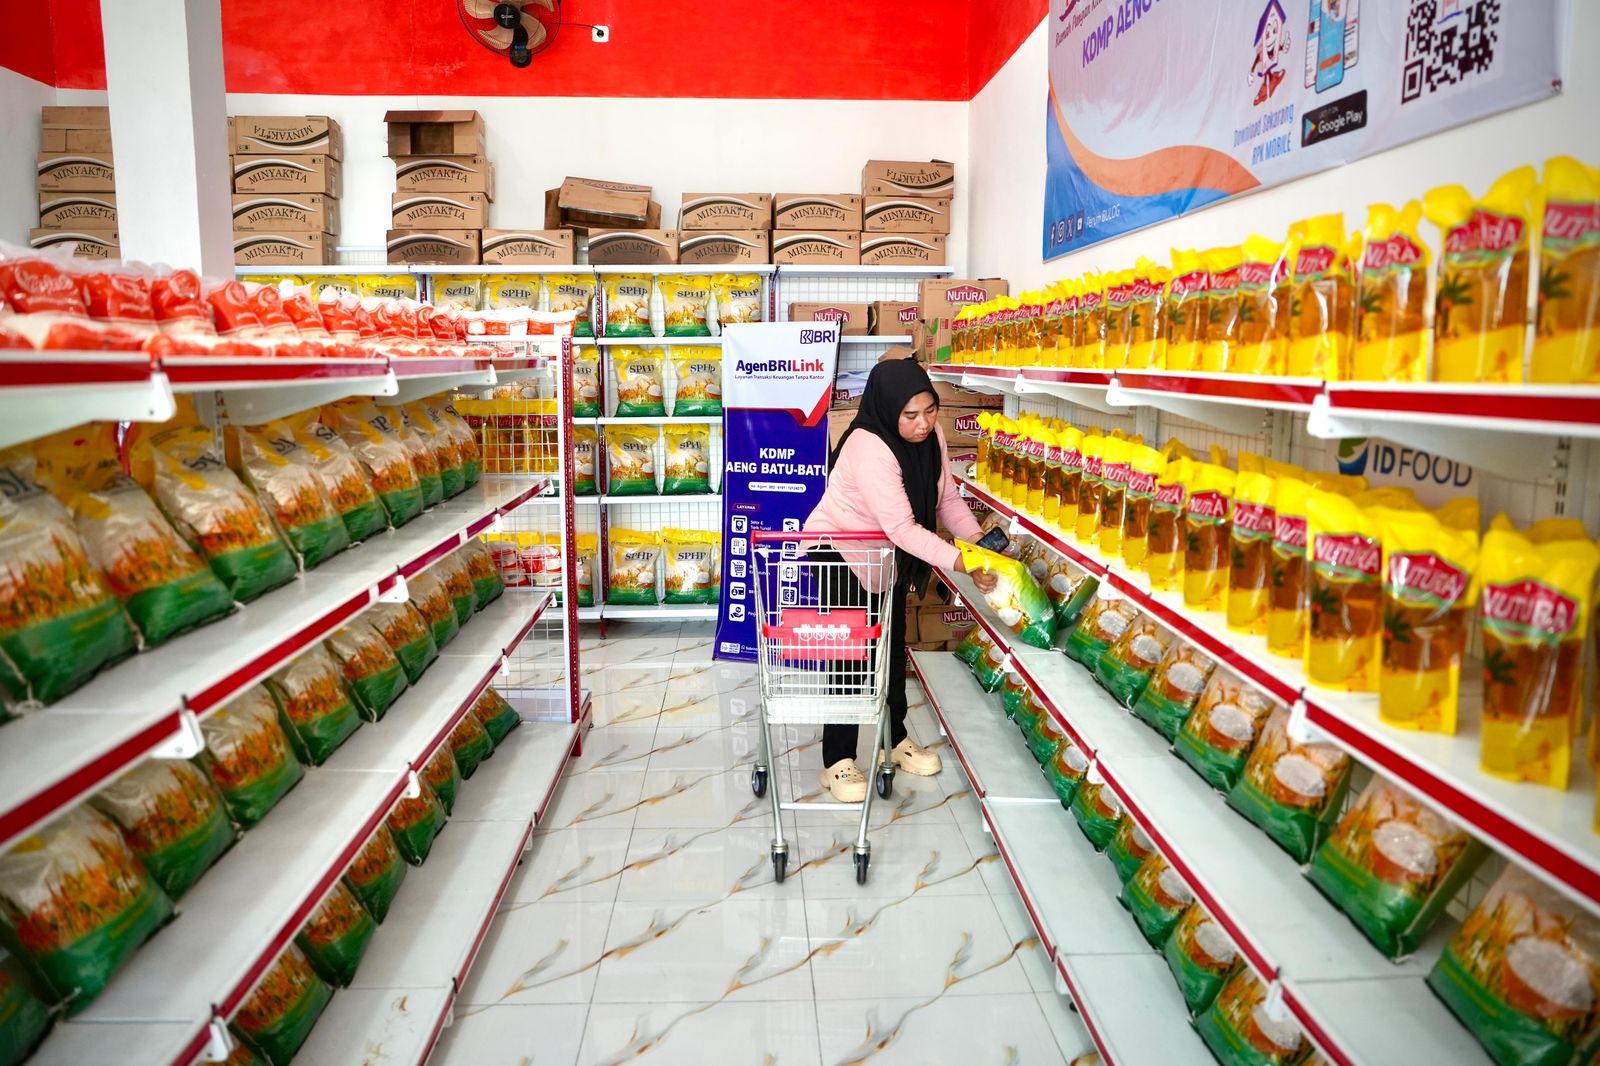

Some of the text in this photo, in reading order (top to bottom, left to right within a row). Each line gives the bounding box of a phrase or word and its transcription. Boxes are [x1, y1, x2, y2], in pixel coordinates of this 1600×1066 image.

[1082, 15, 1114, 68] KDMP
[1318, 110, 1363, 133] Google Play
[253, 124, 314, 141] MINYAKITA
[52, 167, 113, 182] MINYAKITA
[248, 169, 308, 184] MINYAKITA
[410, 169, 468, 184] MINYAKITA
[886, 168, 941, 184] MINYAKITA
[55, 207, 116, 223] MINYAKITA
[247, 208, 307, 224] MINYAKITA
[407, 206, 466, 221] MINYAKITA
[696, 206, 754, 221] MINYAKITA
[790, 208, 846, 222] MINYAKITA
[879, 211, 934, 225] MINYAKITA
[75, 243, 109, 258] AKITA
[244, 245, 304, 261] MINYAKITA
[496, 243, 556, 260] MINYAKITA
[602, 241, 660, 257] MINYAKITA
[694, 244, 751, 259] MINYAKITA
[787, 244, 844, 259] MINYAKITA
[874, 247, 930, 261] MINYAKITA
[375, 288, 405, 297] SPHP
[501, 289, 531, 298] SPHP
[558, 285, 588, 297] SPHP
[619, 287, 648, 298] SPHP
[947, 290, 985, 301] NUTURA
[814, 312, 848, 322] NUTURA
[814, 330, 835, 343] BRI
[690, 364, 716, 374] SPHP
[736, 359, 824, 375] AgenBRILink
[956, 419, 981, 430] NUTU
[759, 448, 795, 460] KDMP
[726, 462, 828, 477] AENG BATU-BATU
[1373, 445, 1472, 487] ID FOOD
[625, 551, 653, 561] SPHP
[678, 552, 706, 560] SPHP
[1315, 535, 1378, 571] NUTURA
[943, 611, 975, 622] NUTUR
[1484, 586, 1568, 634] NUTURA
